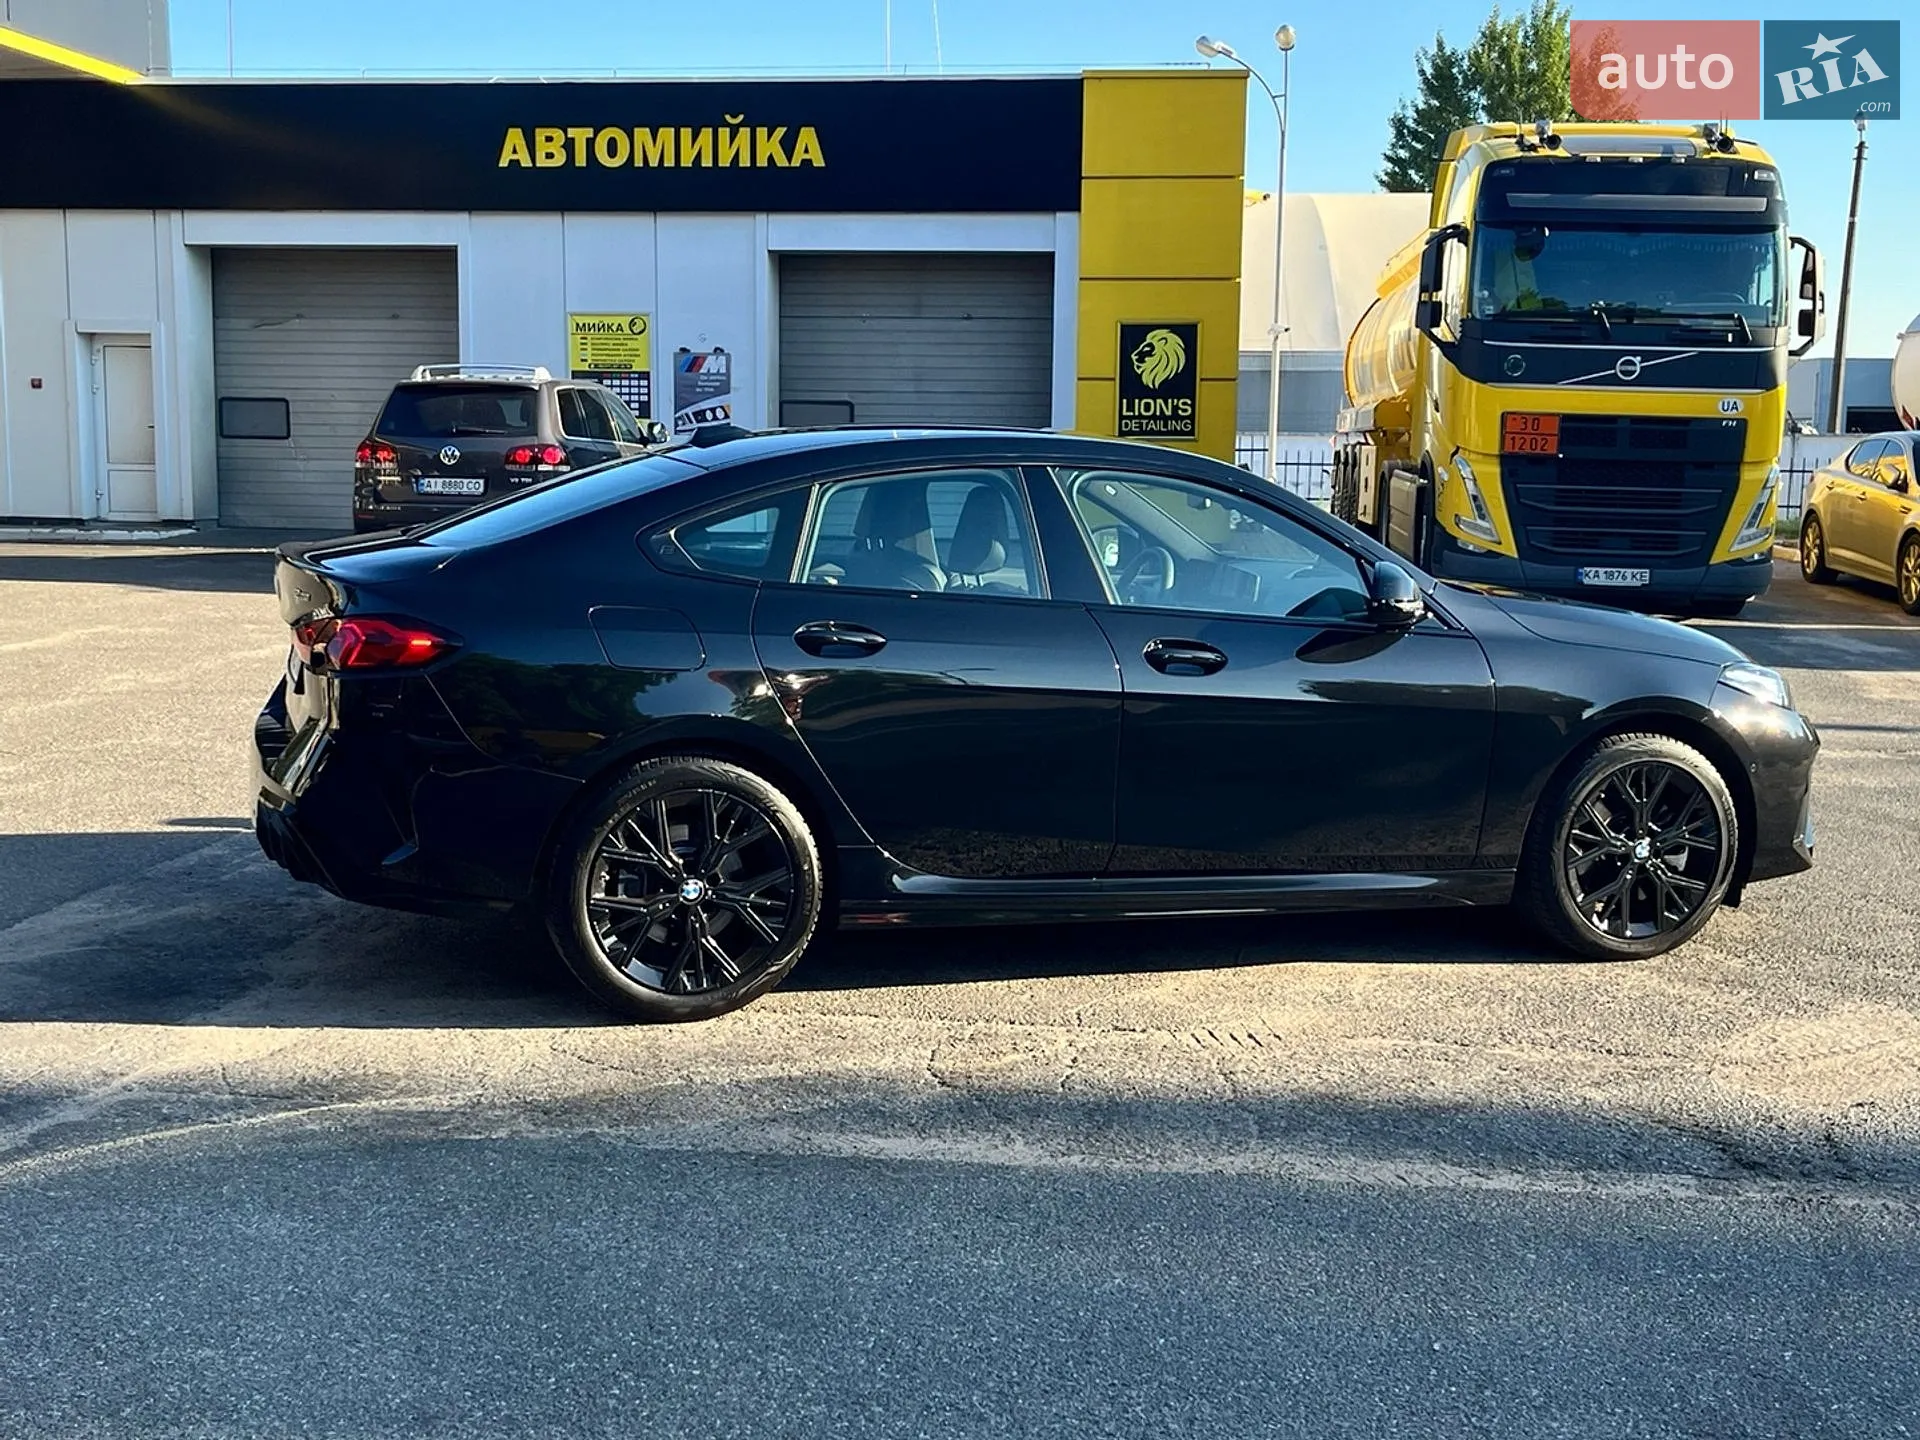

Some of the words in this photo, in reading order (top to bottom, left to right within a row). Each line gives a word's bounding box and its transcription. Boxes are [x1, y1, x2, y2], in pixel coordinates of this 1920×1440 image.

[498, 113, 826, 167] АВТОМИЙКА
[575, 320, 624, 333] МИЙКА
[1122, 398, 1192, 416] LION'S
[1722, 400, 1739, 412] UA
[1121, 419, 1192, 431] DETAILING
[1520, 415, 1541, 431] 30
[1510, 435, 1549, 452] 1202
[466, 480, 481, 491] CO
[1584, 569, 1600, 580] KA
[1603, 570, 1628, 581] 1876
[1631, 570, 1648, 581] KE
